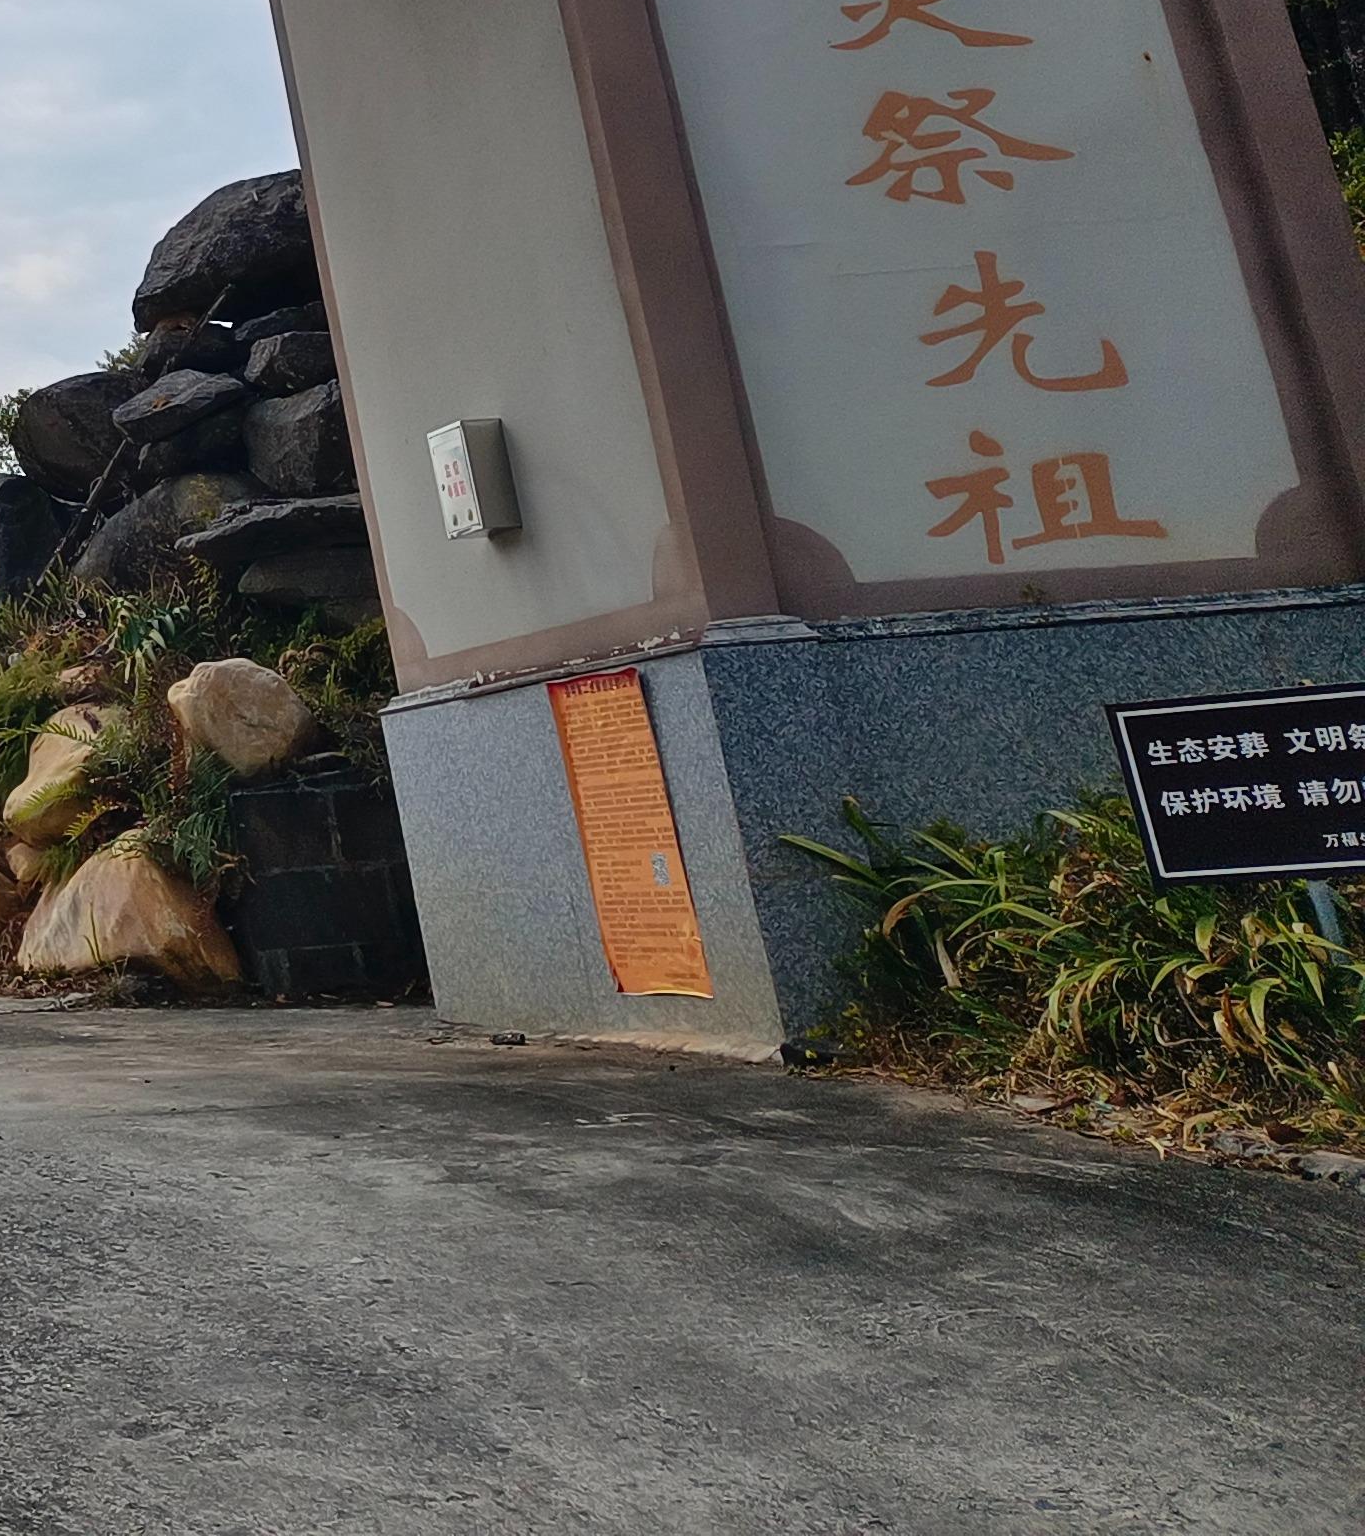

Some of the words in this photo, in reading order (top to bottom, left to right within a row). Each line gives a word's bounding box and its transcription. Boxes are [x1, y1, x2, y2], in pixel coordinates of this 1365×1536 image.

[1147, 731, 1269, 766] 生态安葬
[1160, 783, 1286, 817] 保护环境
[1297, 776, 1365, 808] 请勿
